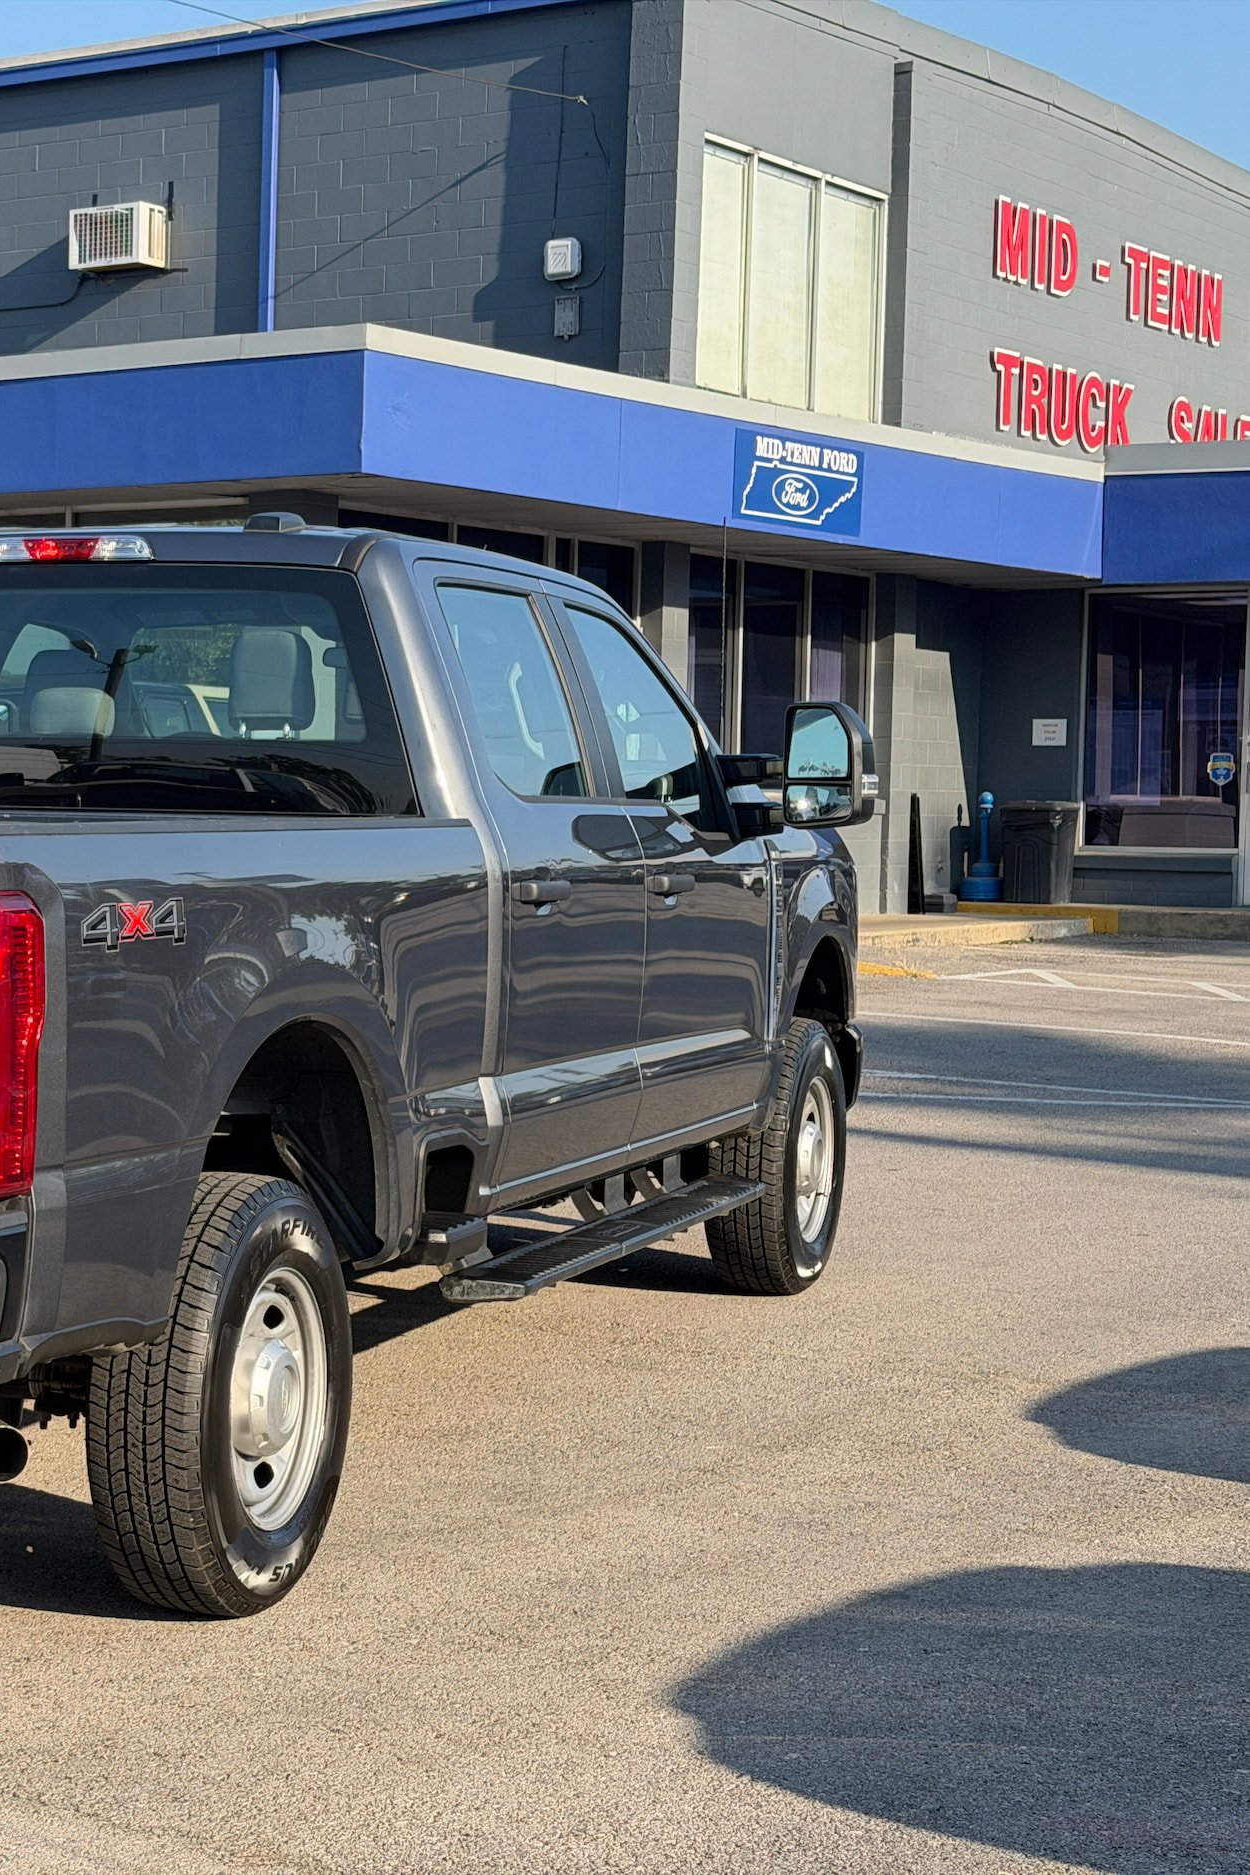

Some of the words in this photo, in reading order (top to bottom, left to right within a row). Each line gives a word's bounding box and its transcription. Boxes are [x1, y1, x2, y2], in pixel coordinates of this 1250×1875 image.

[993, 194, 1079, 297] MID
[1122, 241, 1223, 346] TENN
[991, 346, 1135, 453] TRUCK
[781, 478, 810, 508] Ford
[822, 449, 858, 474] FORD
